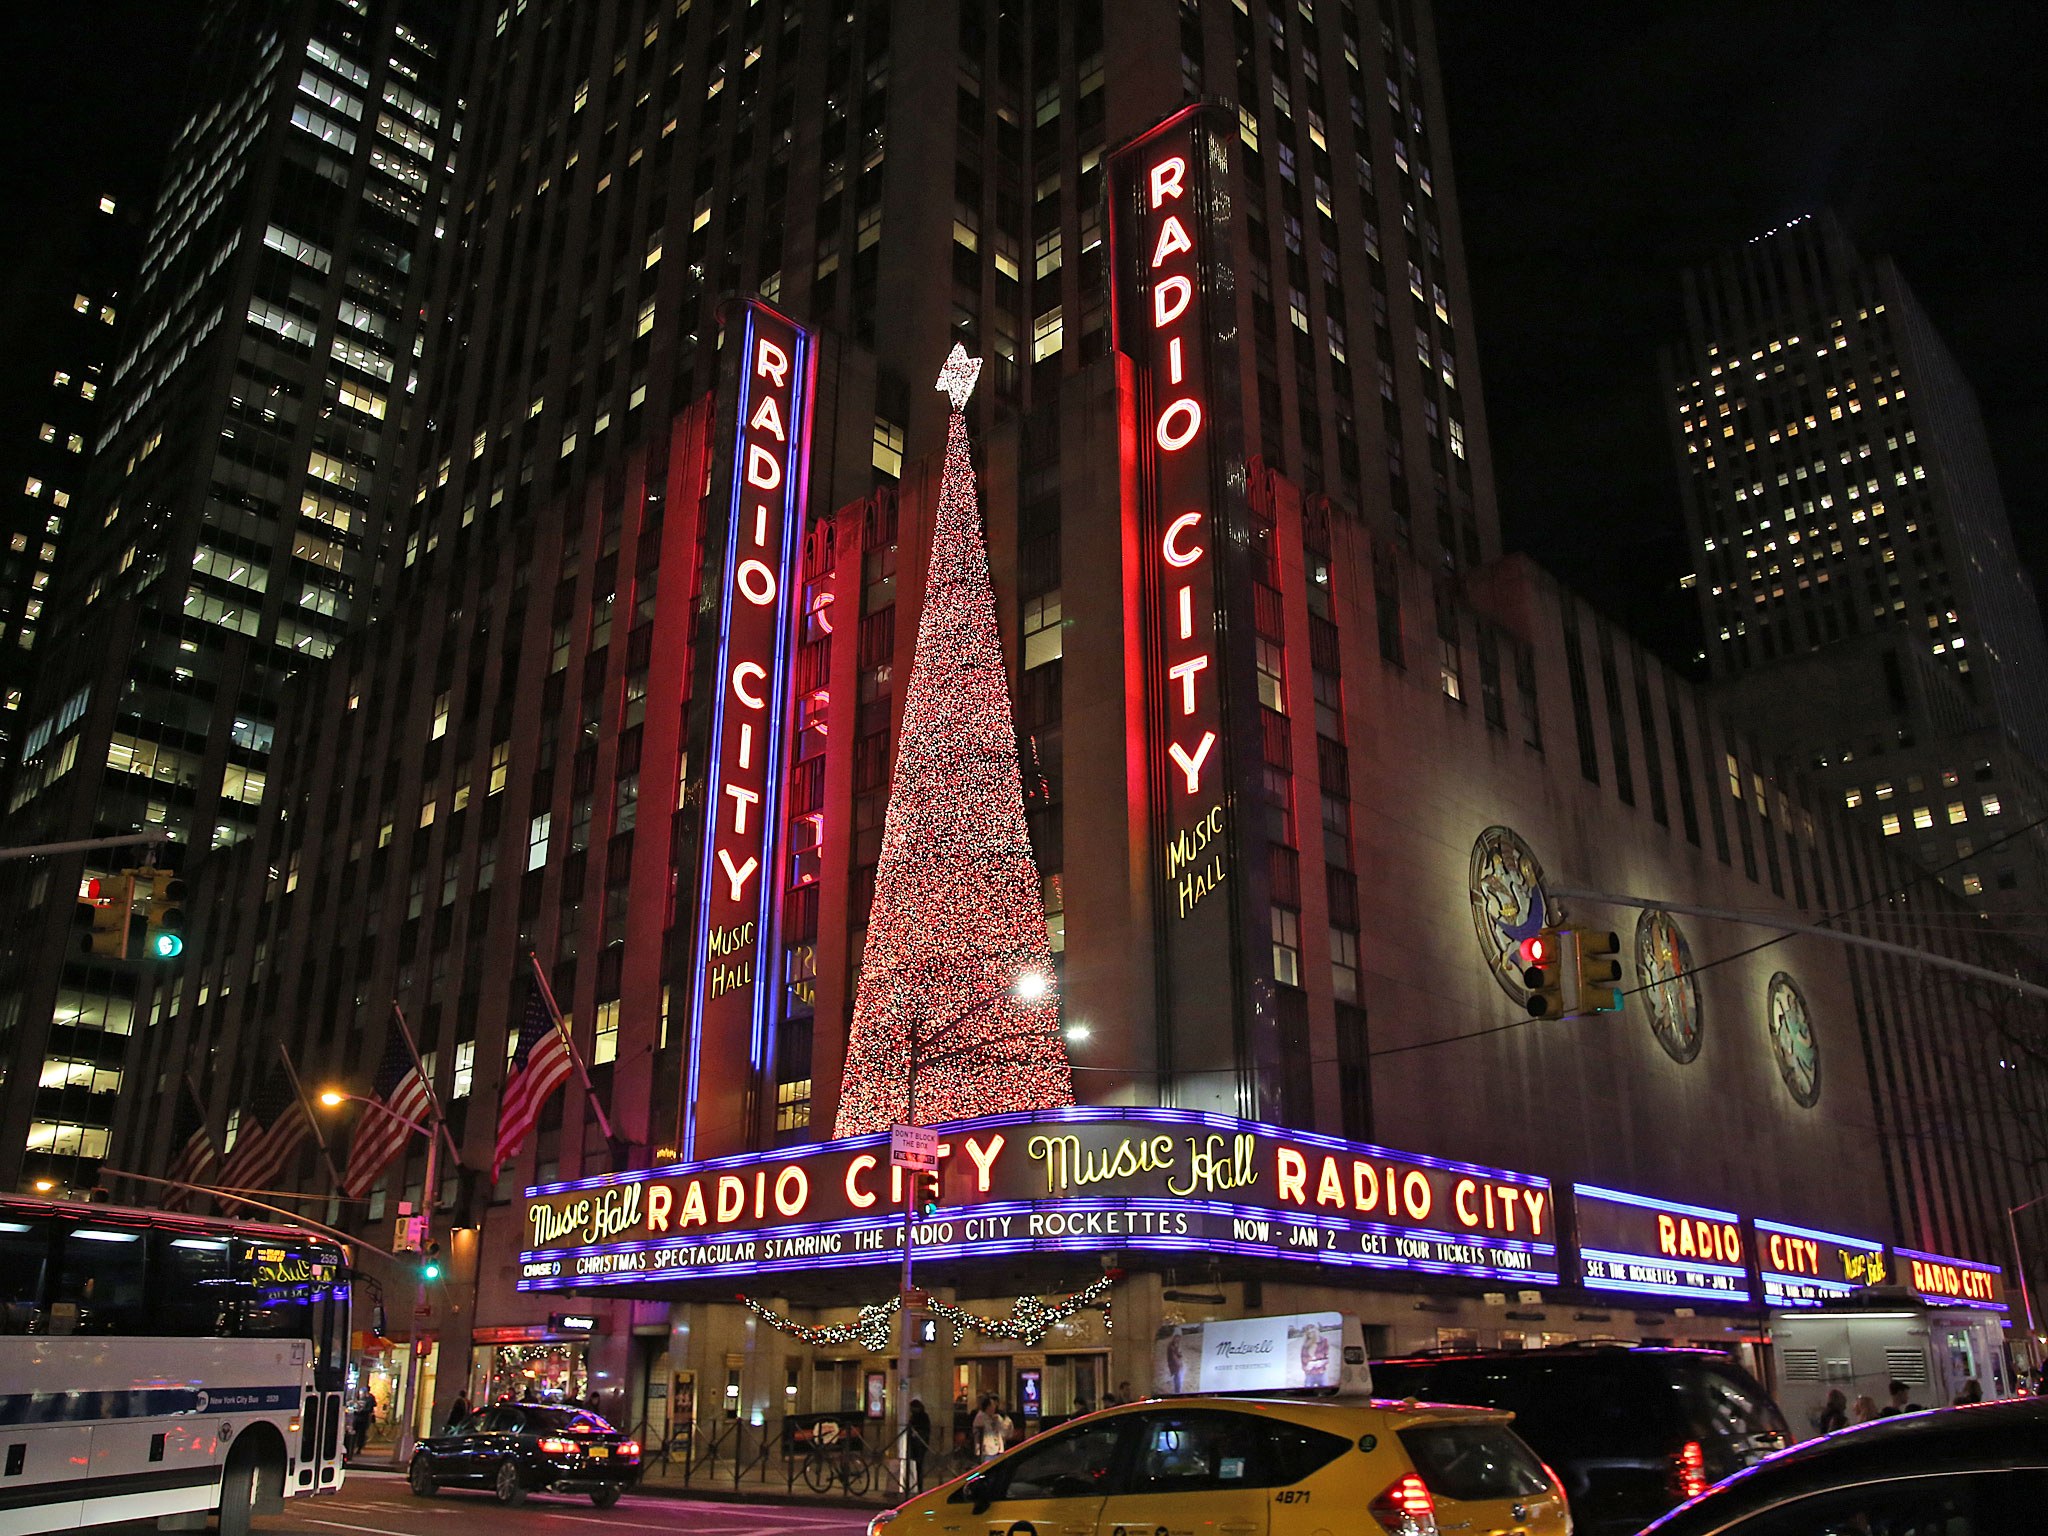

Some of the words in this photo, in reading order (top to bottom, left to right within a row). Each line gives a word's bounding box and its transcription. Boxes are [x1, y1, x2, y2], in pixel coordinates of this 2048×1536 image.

[1151, 156, 1202, 452] RADIO
[737, 337, 789, 606] RADIO
[1162, 510, 1217, 796] CITY
[717, 661, 768, 903] CITY
[1170, 804, 1224, 881] MUSIC
[1180, 854, 1226, 919] HALL
[708, 921, 755, 962] MUSIC
[710, 961, 752, 1001] HALL
[902, 1139, 914, 1148] THE
[915, 1132, 935, 1141] BLOCK
[529, 1199, 590, 1248] Music
[582, 1181, 643, 1245] Hall
[646, 1164, 810, 1233] RADIO
[844, 1133, 1006, 1208] CIY
[1028, 1133, 1175, 1193] Music
[1167, 1132, 1260, 1197] Hall
[1276, 1146, 1433, 1221] RADIO
[1454, 1177, 1546, 1236] CITY
[576, 1253, 647, 1276] CHRISTMAS
[653, 1241, 756, 1269] SPECTACULAR
[764, 1232, 842, 1260] STARRING
[853, 1228, 884, 1251] THE
[896, 1221, 954, 1248] RADIO
[965, 1215, 1013, 1242] CITY
[1029, 1211, 1189, 1236] ROCKETTES
[1233, 1218, 1270, 1243] NOW
[1288, 1225, 1318, 1248] JAN
[1326, 1229, 1337, 1251] 2
[1361, 1232, 1388, 1255] GET
[1394, 1236, 1430, 1261] YOUR
[1435, 1242, 1485, 1265] TICKETS
[1488, 1251, 1533, 1270] TODAY!
[1657, 1212, 1741, 1264] RADIO
[1769, 1233, 1820, 1276] CITY
[523, 1263, 552, 1277] CHASE
[1587, 1260, 1606, 1278] SEE
[1608, 1262, 1627, 1281] THE
[1911, 1259, 1959, 1297] RADIO
[1961, 1268, 1994, 1301] CITY
[1215, 1339, 1274, 1359] Madewell
[210, 1396, 223, 1405] New
[223, 1396, 236, 1404] York
[236, 1395, 248, 1405] City
[248, 1395, 259, 1404] Bus
[1275, 1490, 1311, 1505] 4B71
